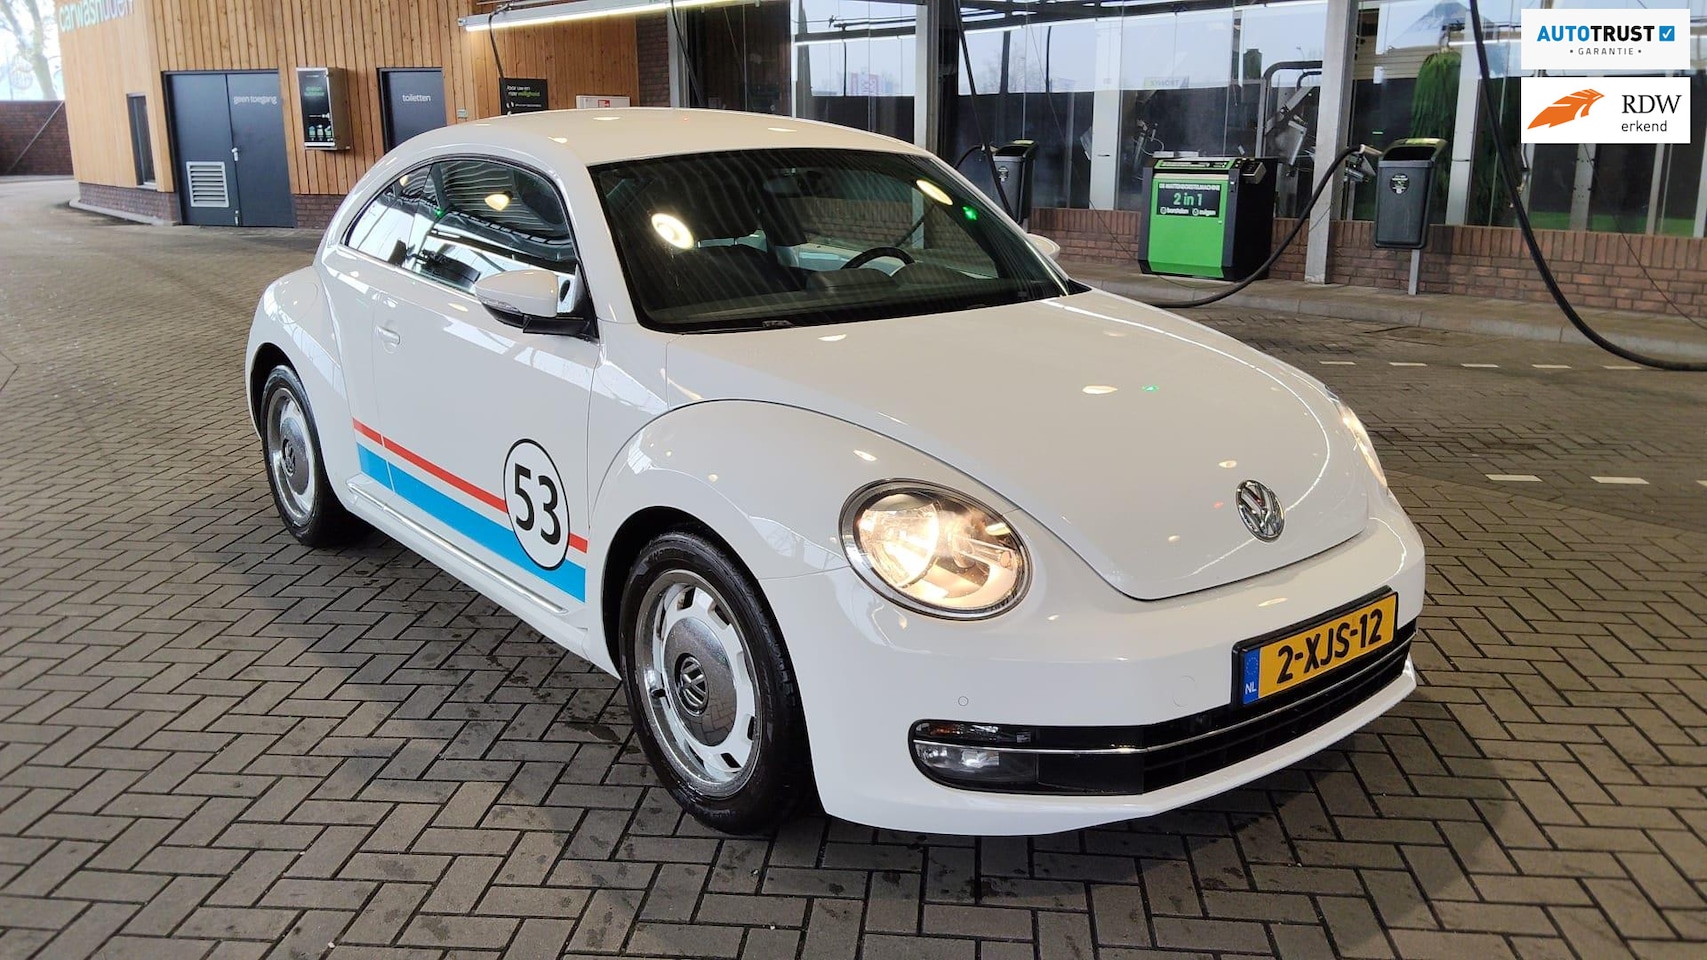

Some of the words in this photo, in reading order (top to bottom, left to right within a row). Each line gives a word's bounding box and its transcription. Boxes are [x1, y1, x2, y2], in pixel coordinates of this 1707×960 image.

[233, 95, 249, 105] geen
[250, 95, 278, 105] toegang
[402, 93, 432, 102] toiletten
[1173, 192, 1181, 206] 2
[1183, 192, 1194, 206] in
[1197, 193, 1203, 207] 1
[514, 462, 561, 546] 53
[1276, 608, 1383, 684] 2-XJS-12
[1244, 681, 1257, 695] NL
